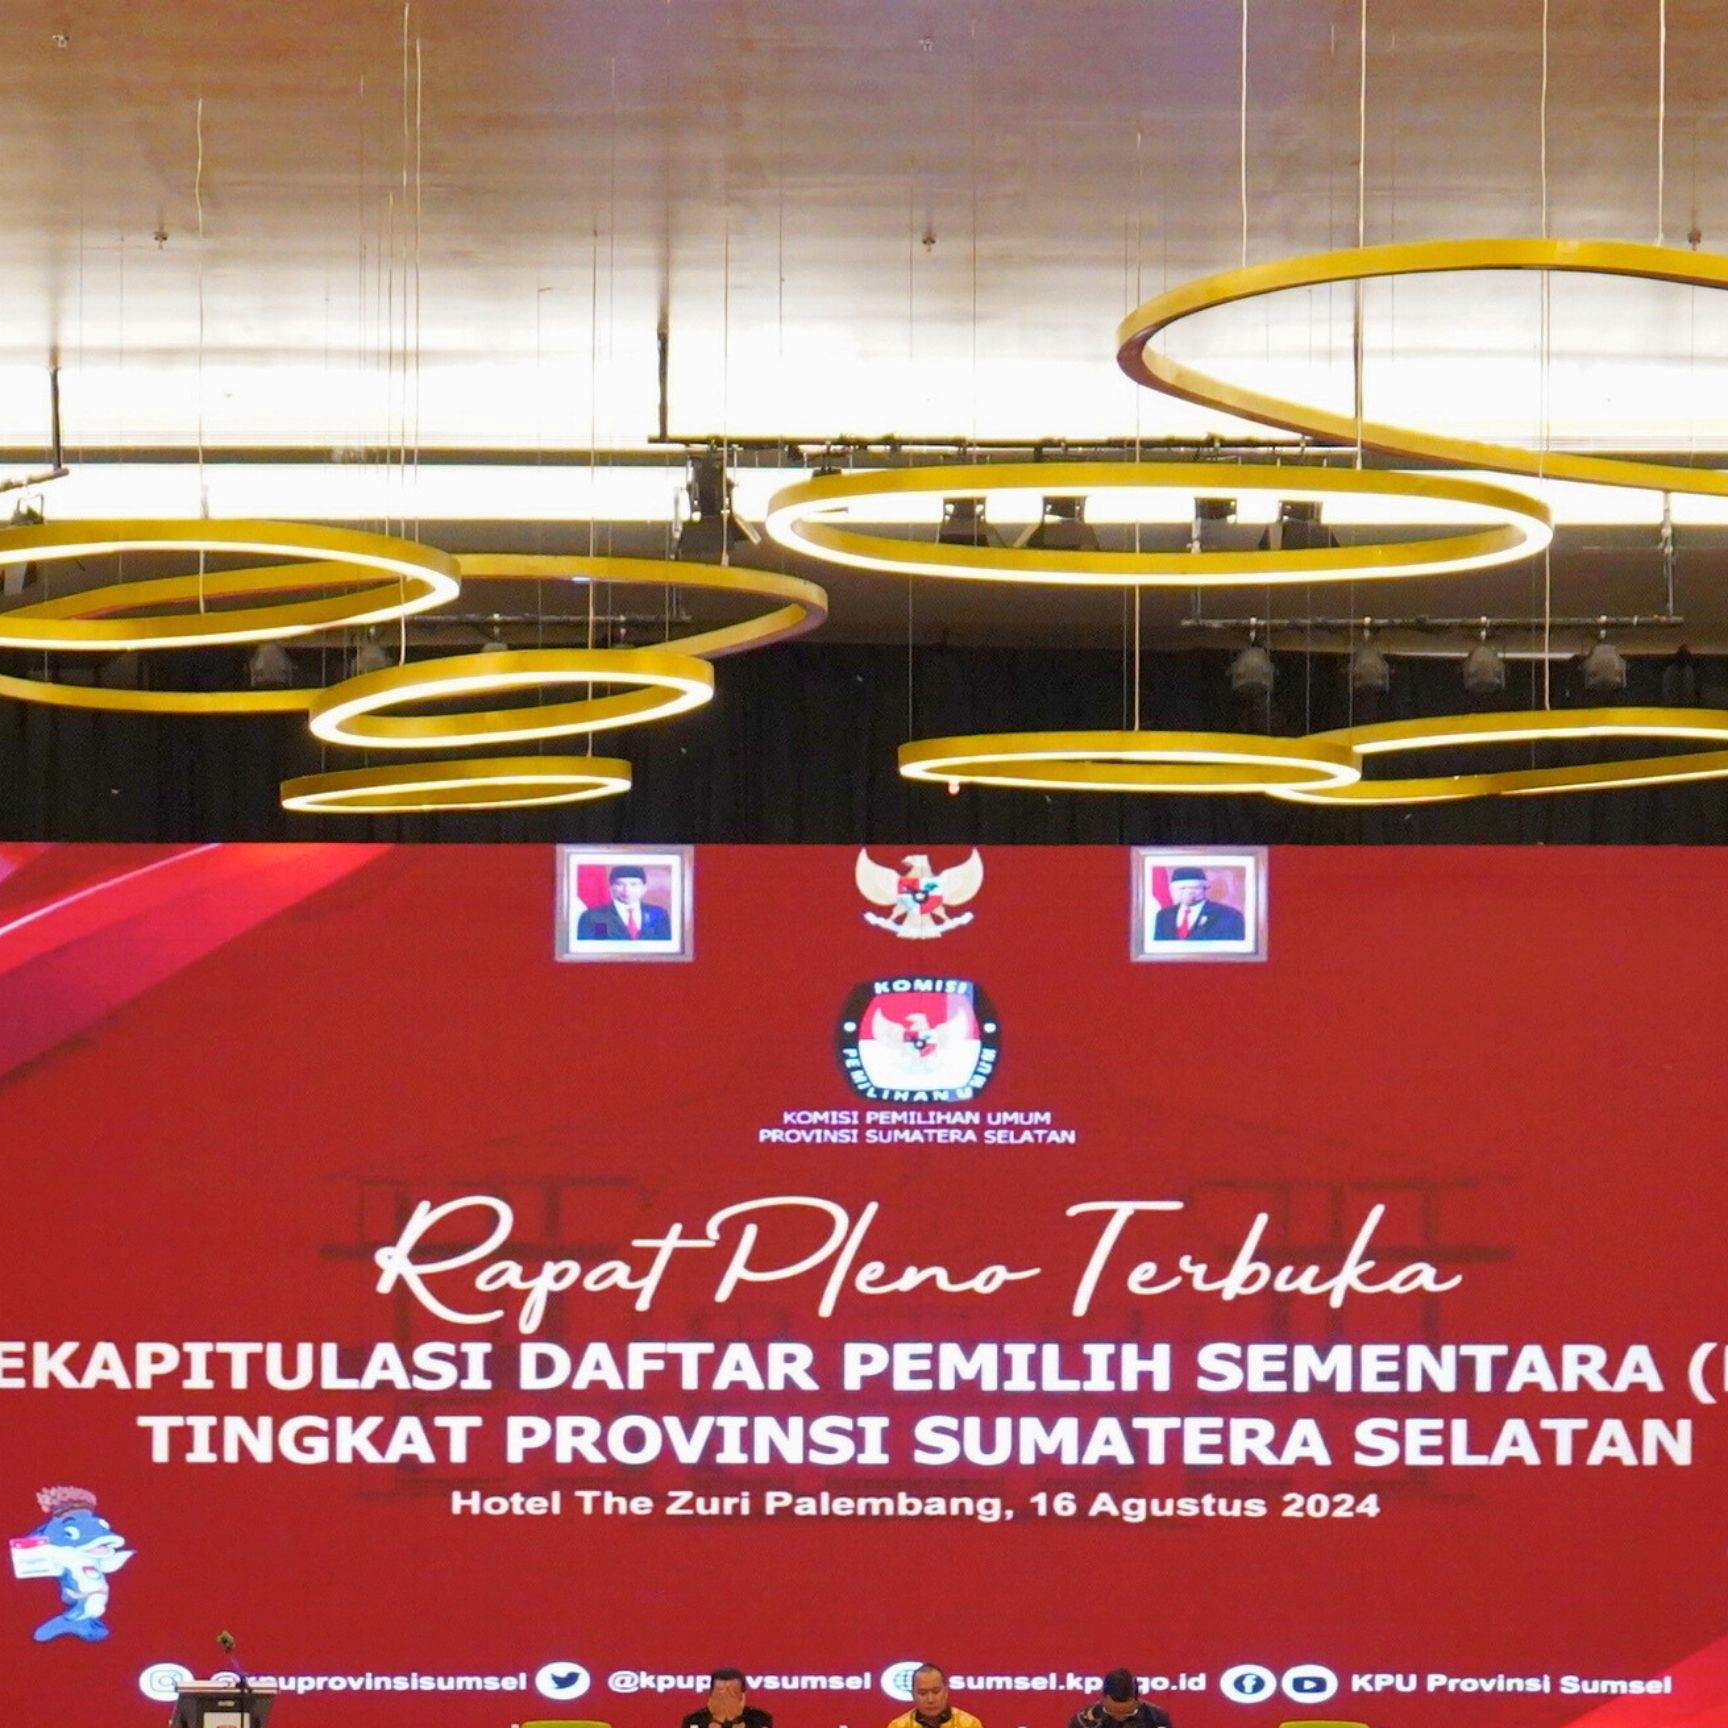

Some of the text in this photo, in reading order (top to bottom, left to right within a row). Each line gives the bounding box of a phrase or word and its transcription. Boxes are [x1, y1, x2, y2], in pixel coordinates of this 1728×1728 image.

[873, 978, 968, 995] KOMISI
[842, 1047, 997, 1102] PEMILIHAN UMUM
[783, 1110, 1052, 1126] KOMISI PEMILIHAN UMUM
[758, 1128, 1076, 1145] PROVINSI SUMATERA SELATAN
[374, 1194, 1463, 1335] Rapat Pleno Terbuka
[519, 1341, 820, 1391] DAFTAR
[843, 1342, 1171, 1392] PEMILIH
[1196, 1341, 1664, 1393] SEMENTARA
[136, 1414, 1692, 1467] TINGKAT PROVINSI SUMATERA SELATAN
[451, 1490, 1381, 1524] Hotel The Zuri Palembang, 16 Agustus 2024
[209, 1671, 527, 1695] uprovinsisumsel
[607, 1669, 872, 1694] @kpupvsumsel
[948, 1672, 1207, 1696] sumsel.kpgo.id
[1351, 1673, 1673, 1695] KPU Provinsi Sumsel
